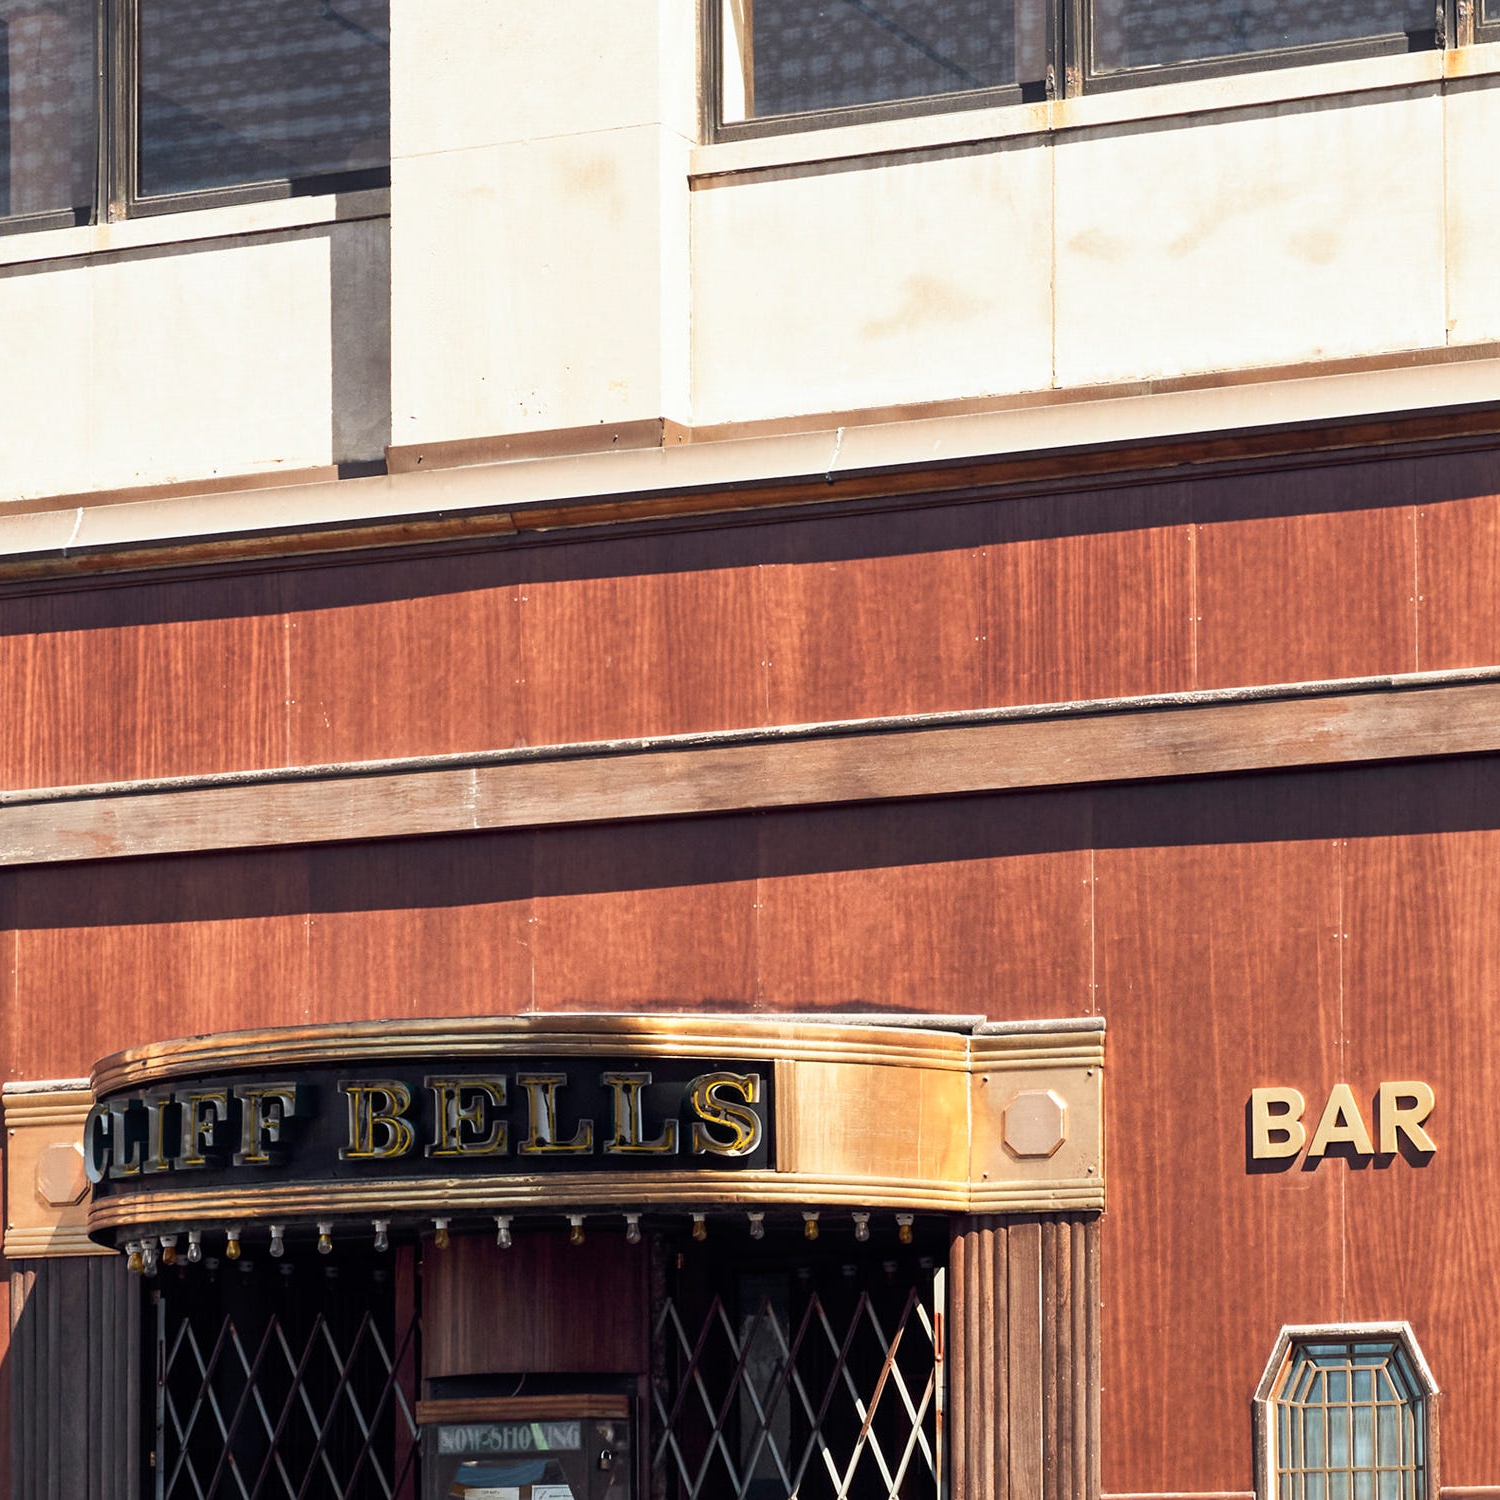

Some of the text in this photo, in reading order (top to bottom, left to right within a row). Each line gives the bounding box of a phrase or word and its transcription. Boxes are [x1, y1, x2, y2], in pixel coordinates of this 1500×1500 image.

[83, 1070, 762, 1184] CLIFF BELLS
[1251, 1080, 1437, 1160] BAR
[440, 1428, 481, 1451] NOW
